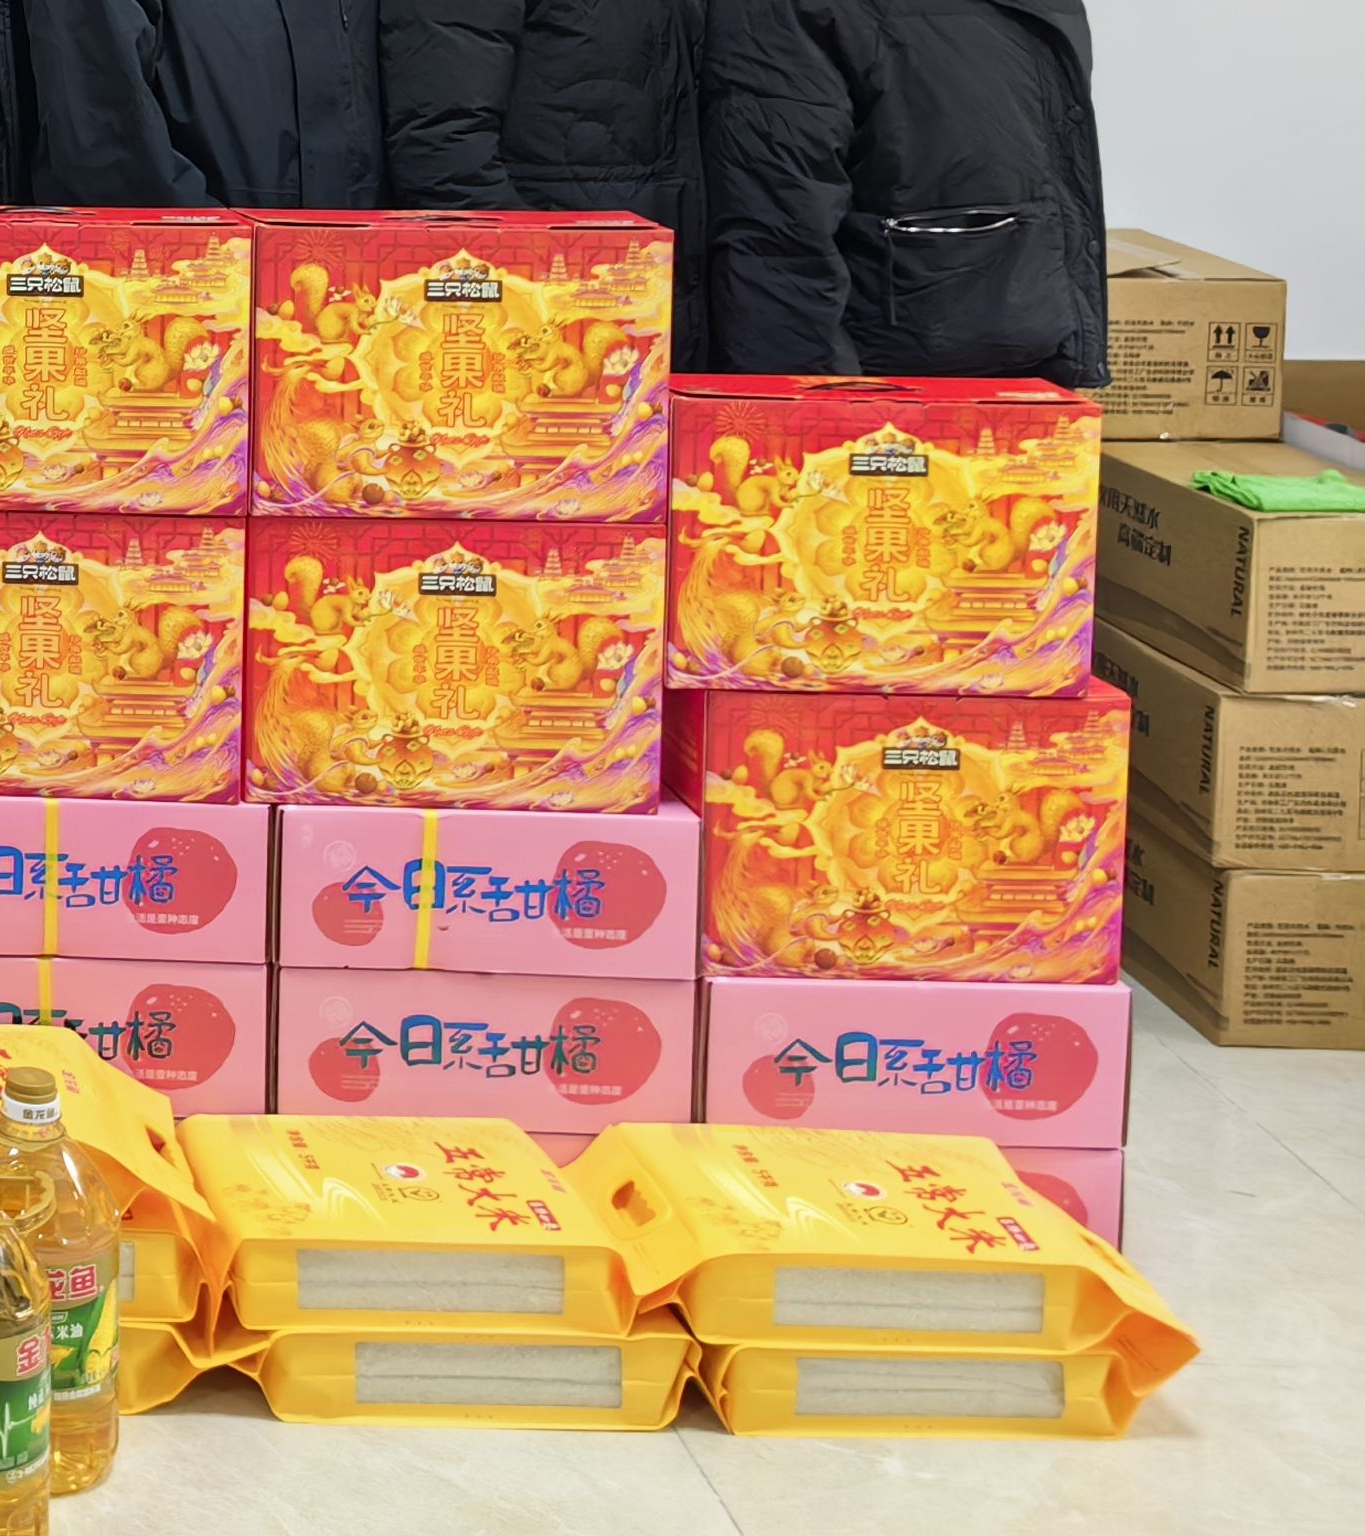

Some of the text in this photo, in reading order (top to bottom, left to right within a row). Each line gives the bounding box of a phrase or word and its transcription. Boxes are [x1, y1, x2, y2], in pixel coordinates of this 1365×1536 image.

[10, 276, 81, 293] 三只松鼠
[427, 281, 500, 299] 三只松鼠
[23, 309, 70, 420] 坚果礼
[440, 314, 488, 427] 坚果礼
[852, 455, 926, 473] 三只松鼠
[5, 564, 76, 581] 三只松鼠
[422, 575, 493, 592] 三只松鼠
[864, 488, 912, 601] 坚果礼
[1118, 522, 1172, 567] 高端定制
[1231, 526, 1250, 617] NATURAL
[18, 596, 65, 707] 坚果礼
[434, 608, 481, 719] 坚果礼
[884, 749, 957, 767] 三只松鼠
[1199, 706, 1215, 795] NATURAL
[896, 781, 944, 894] 坚果礼
[1208, 879, 1224, 969] NATURAL
[23, 1108, 55, 1120] 金龙鱼
[434, 1141, 531, 1231] 五常大米
[885, 1160, 1007, 1254] 五常大米
[44, 1264, 98, 1302] 龙鱼
